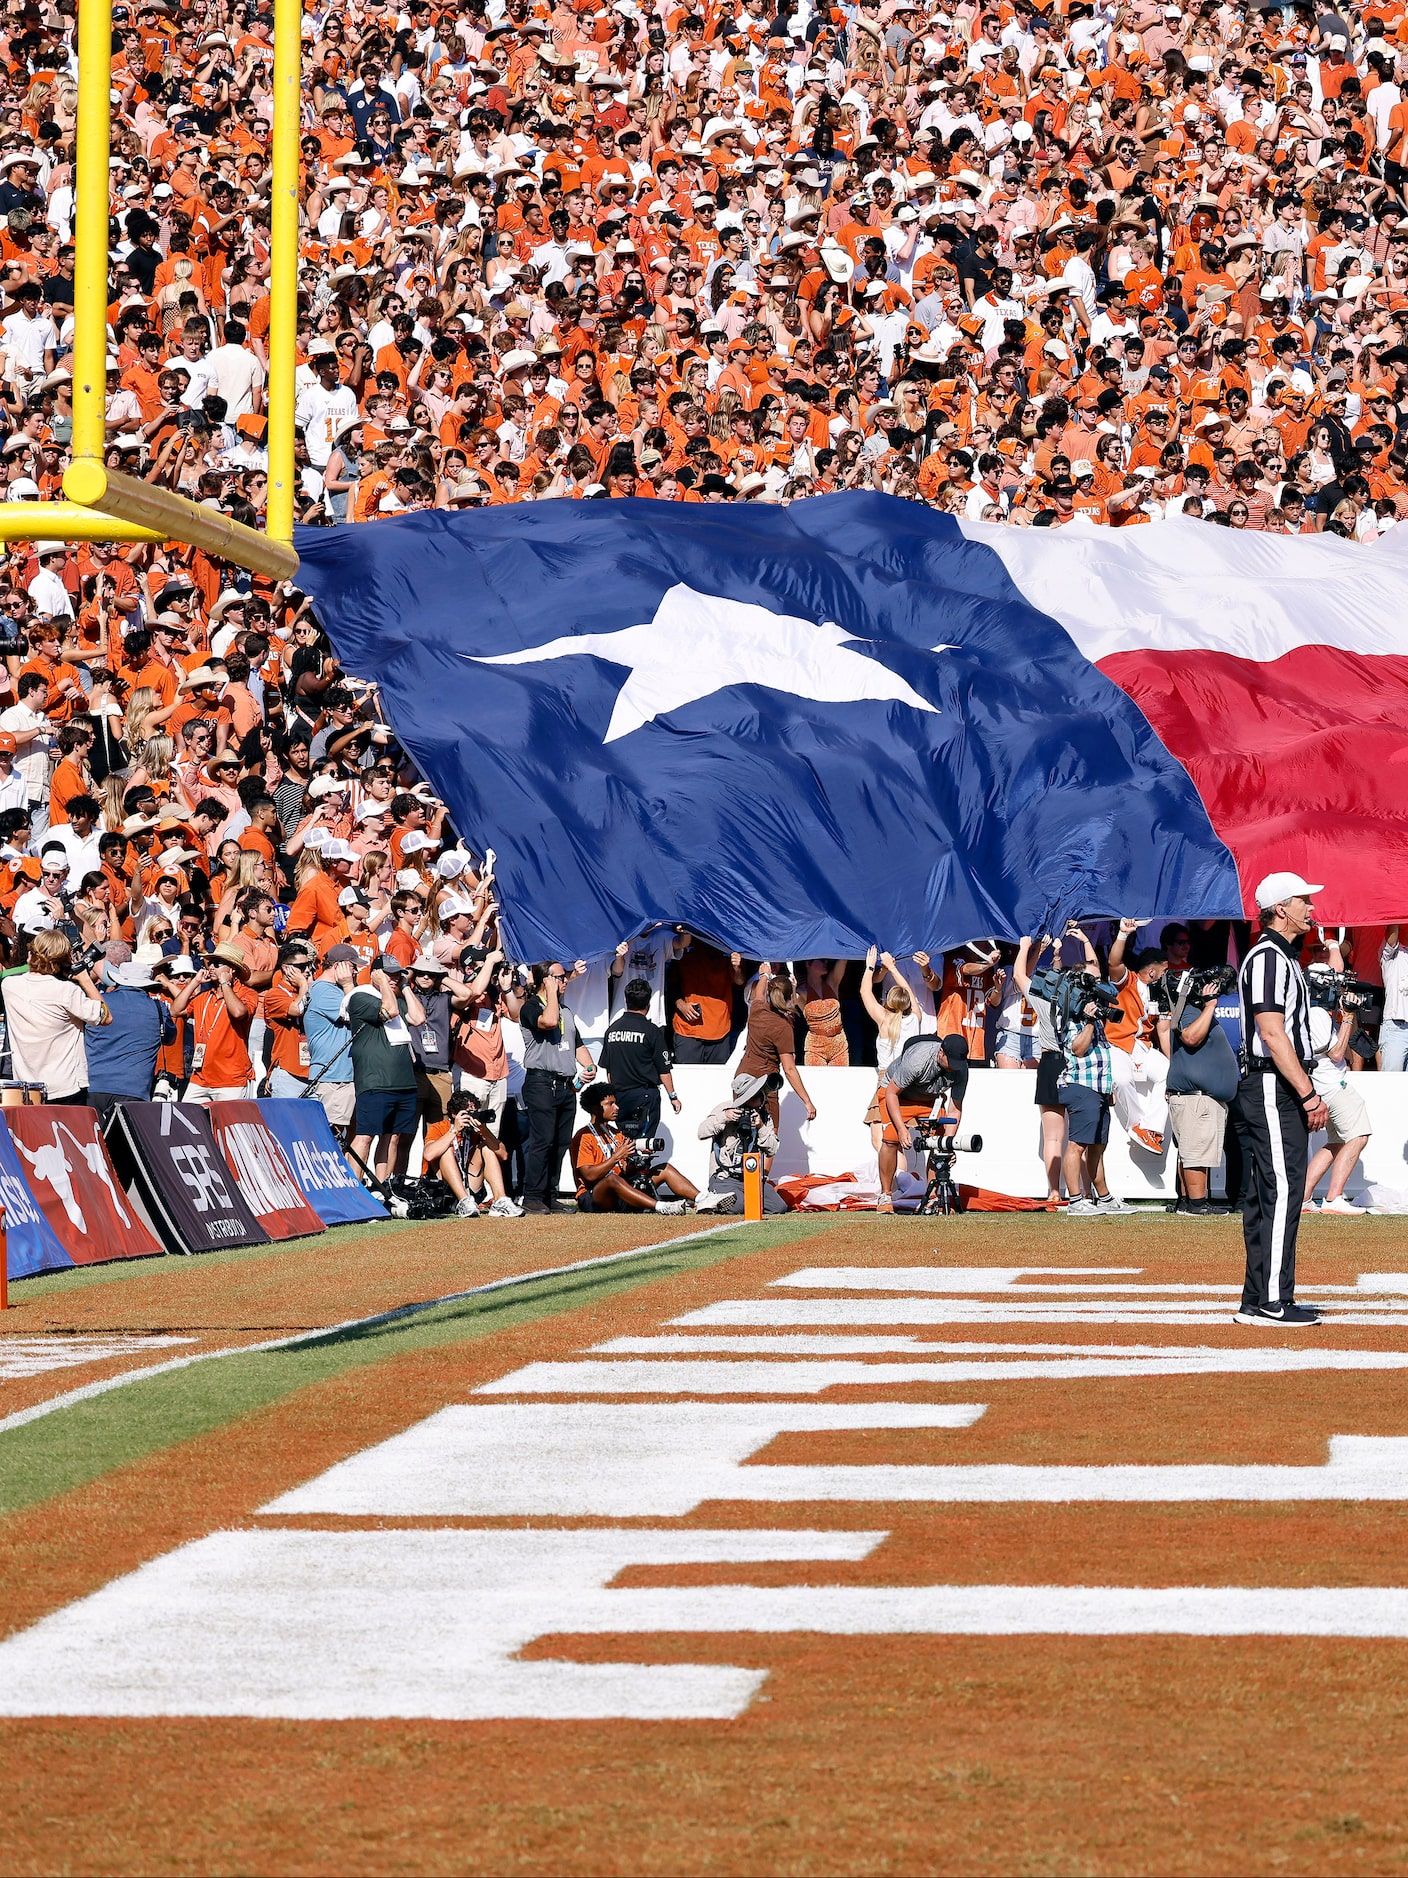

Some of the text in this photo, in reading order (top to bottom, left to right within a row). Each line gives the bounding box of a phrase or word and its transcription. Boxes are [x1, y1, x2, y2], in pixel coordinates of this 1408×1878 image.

[651, 245, 658, 256] 3
[994, 308, 1017, 317] TEXAS
[327, 408, 345, 416] TEXAS
[962, 989, 985, 1029] 12
[1215, 1007, 1240, 1019] SECUR
[607, 1030, 645, 1044] SECURITY
